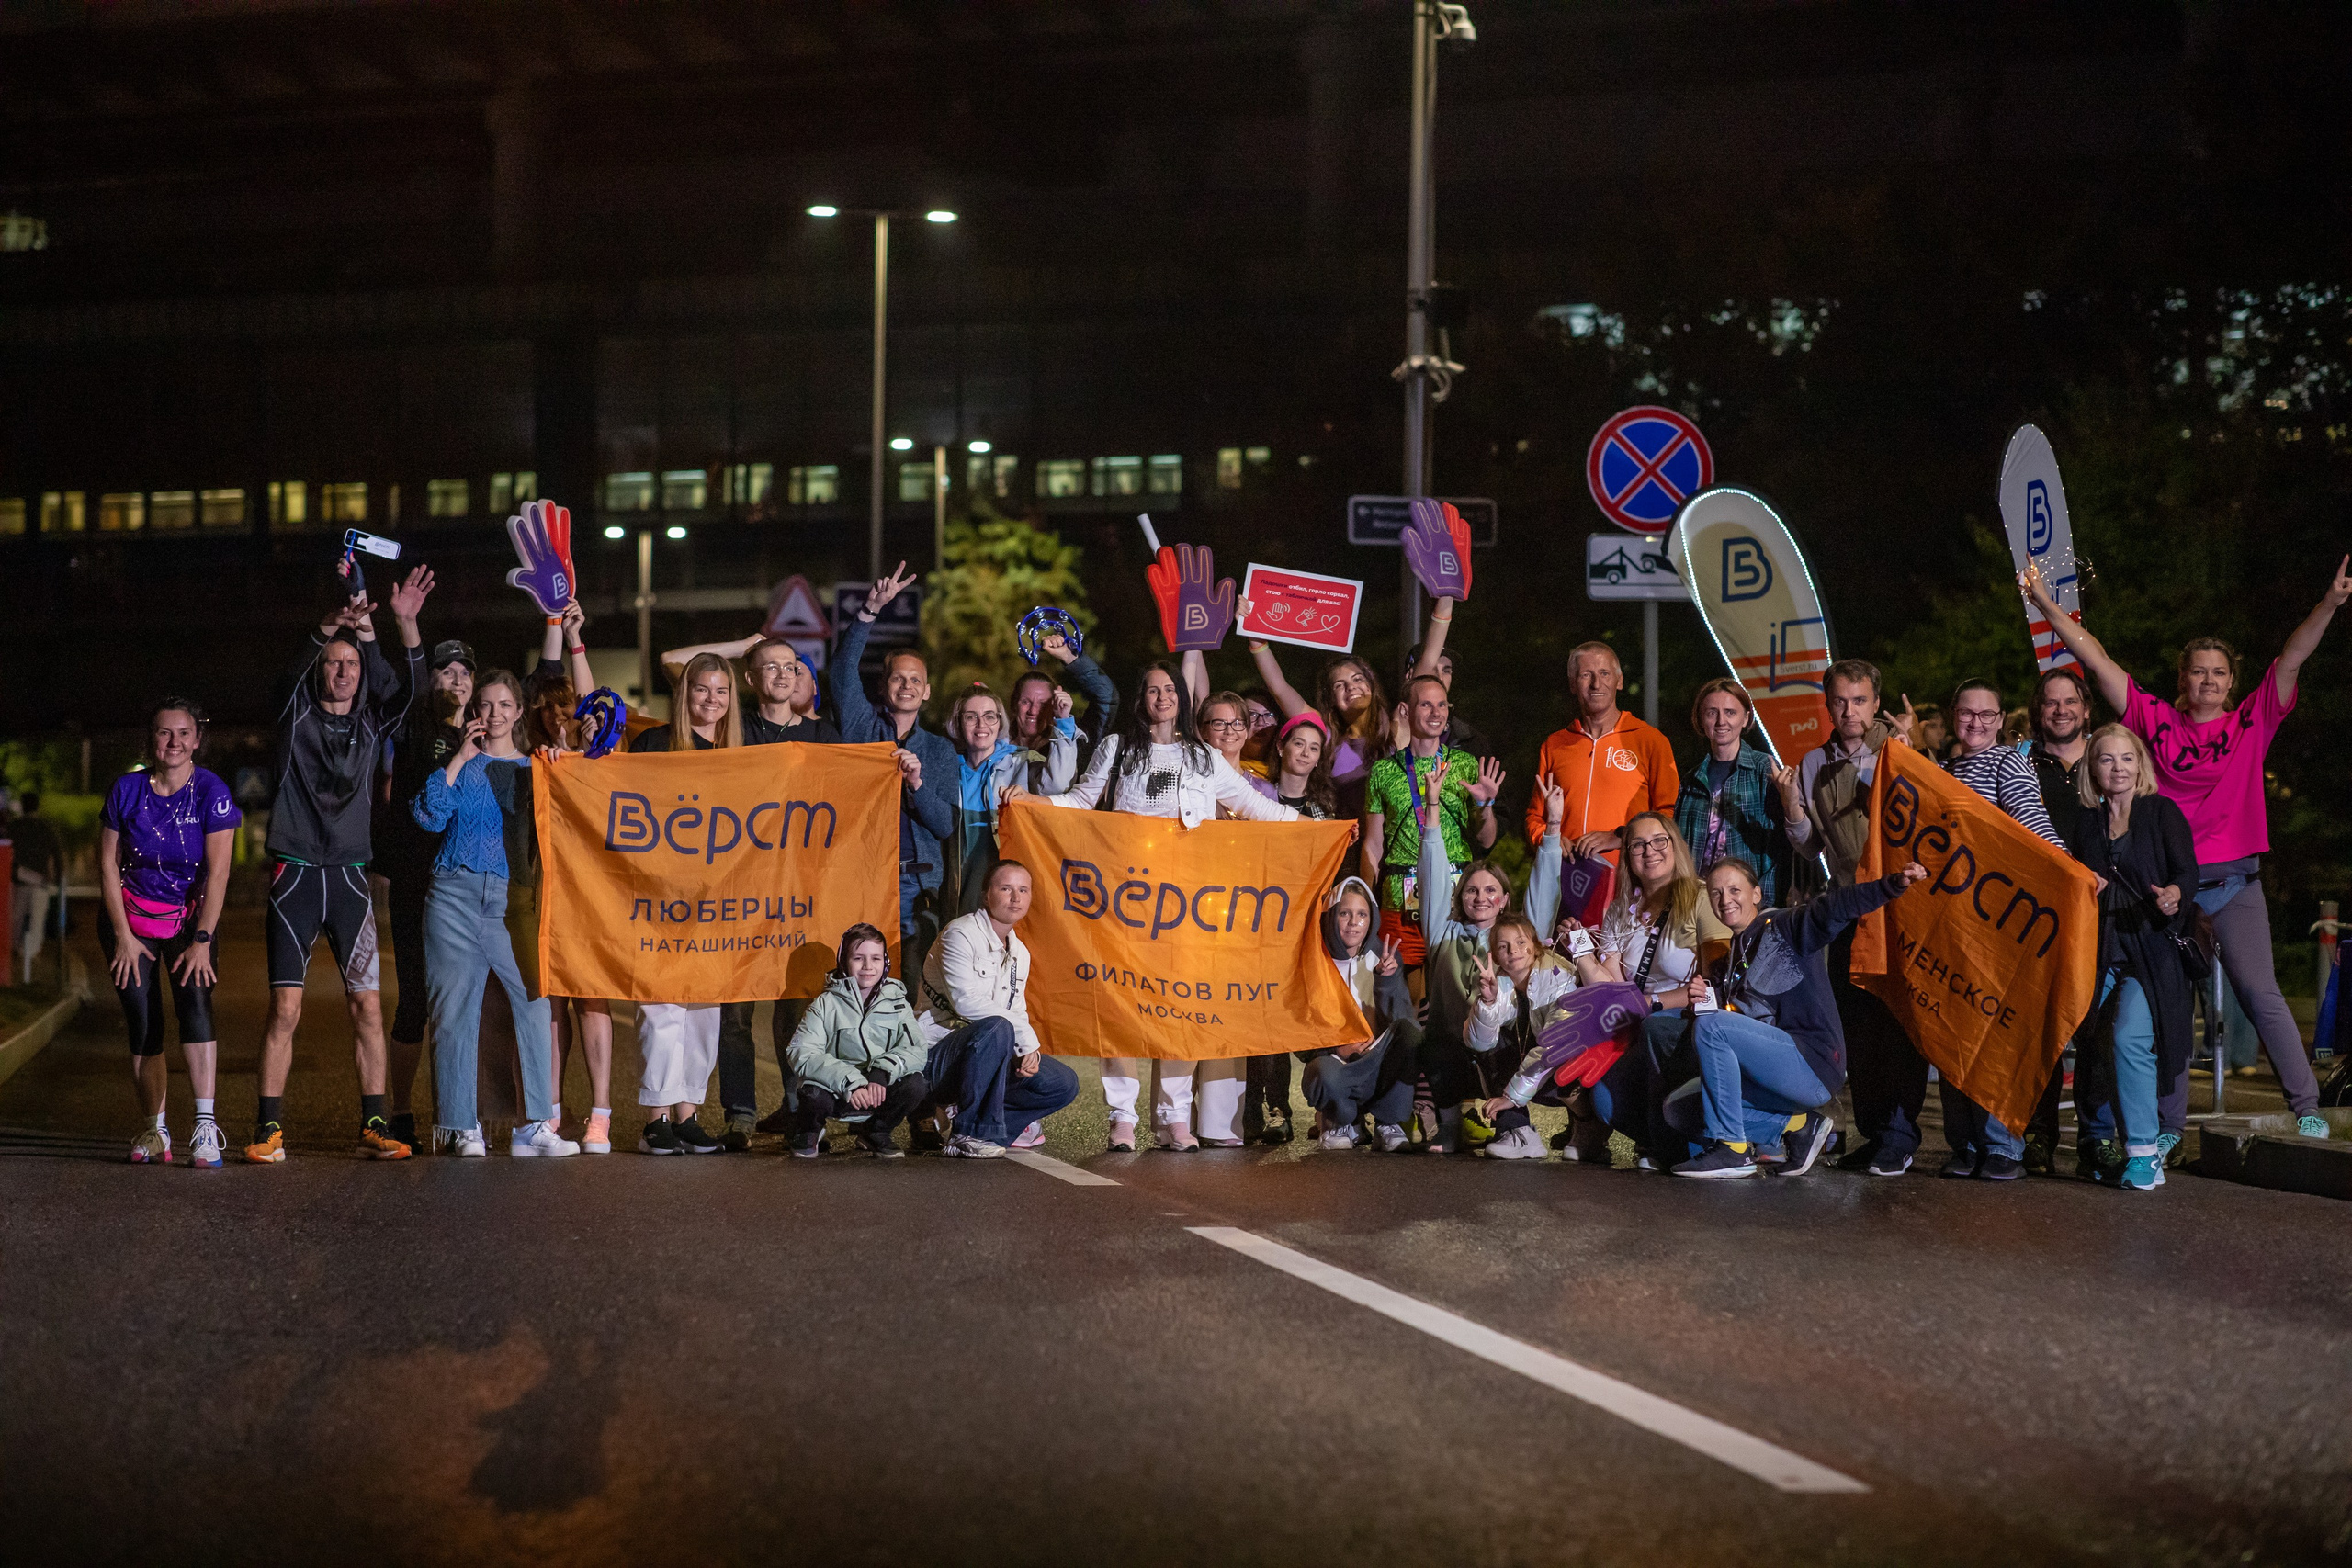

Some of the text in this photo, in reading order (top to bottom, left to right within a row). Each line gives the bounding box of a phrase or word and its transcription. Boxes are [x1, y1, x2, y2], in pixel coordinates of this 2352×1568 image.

[1288, 584, 1308, 592] отбил,
[1308, 588, 1327, 596] горло
[1327, 591, 1350, 600] сорвал,
[629, 895, 813, 923] ЛЮБЕРЦЫ
[640, 930, 807, 953] НАТАШИНСКИЙ
[1639, 938, 1657, 973] PUMA
[1075, 962, 1279, 1001] ФИЛАТОВ ЛУГ
[1896, 931, 2017, 1030] МЕНСКОЕ
[1138, 1002, 1224, 1026] МОСКВА
[1906, 982, 1941, 1018] КВА
